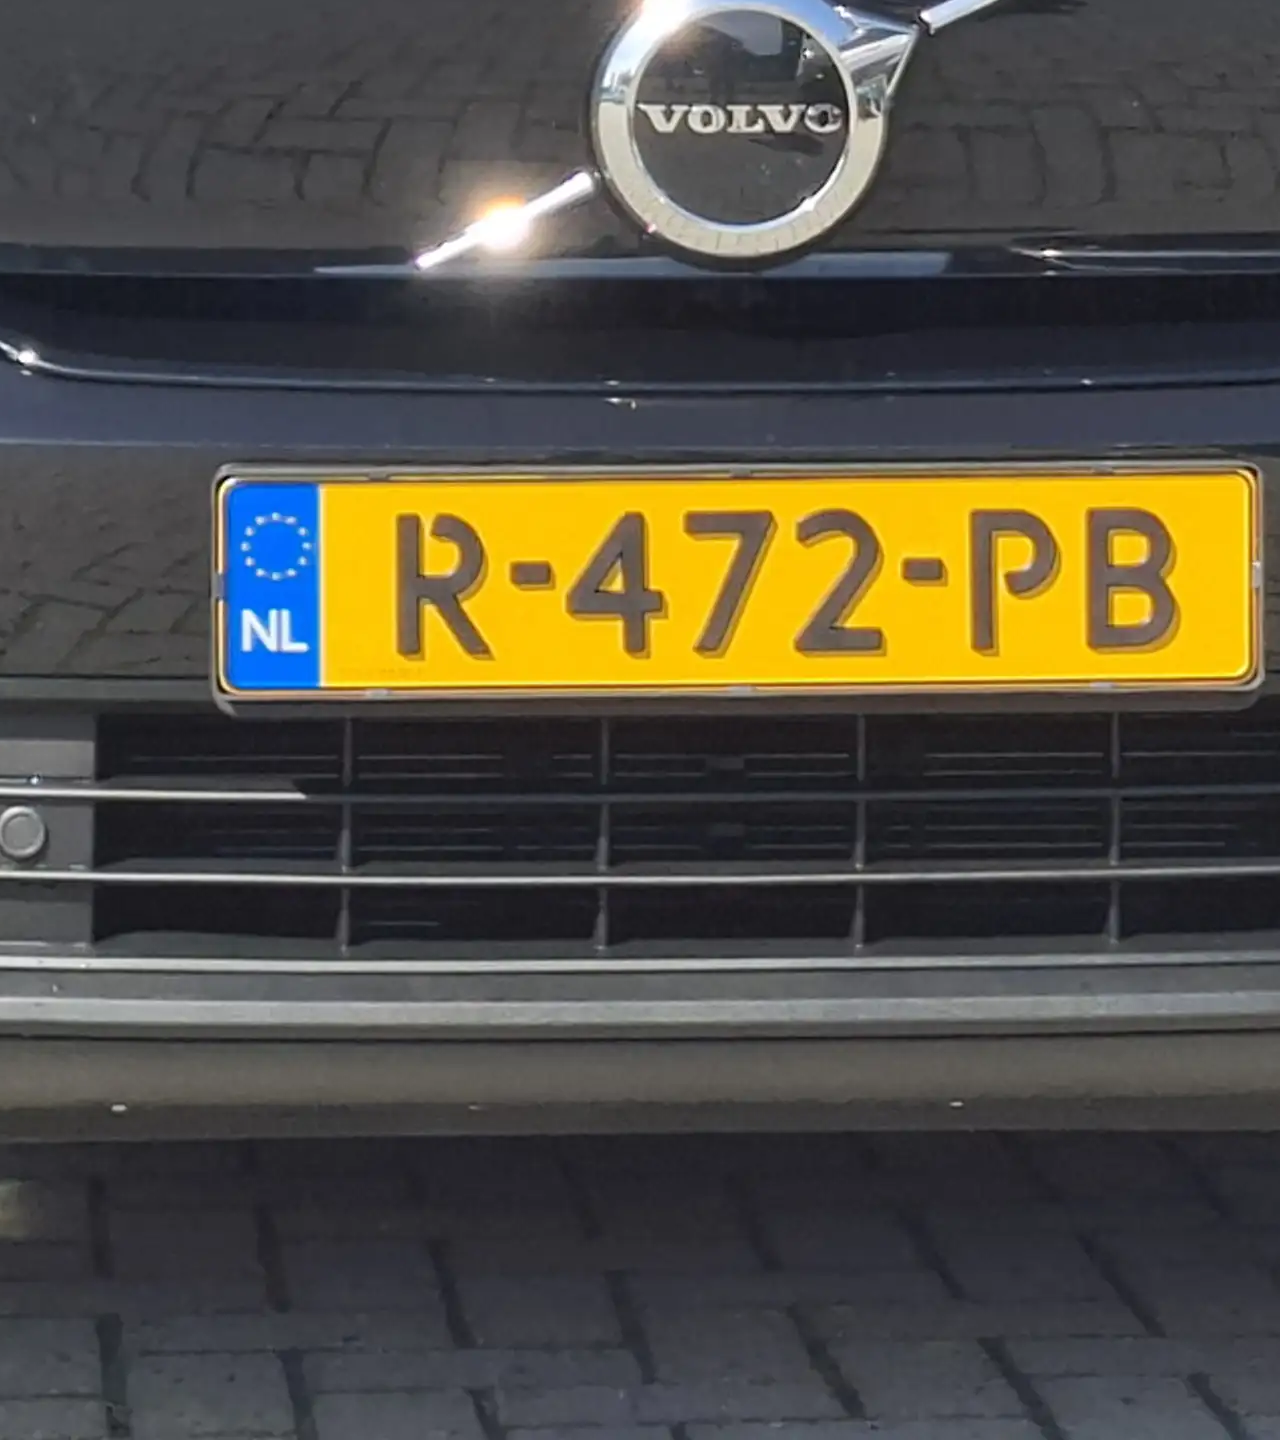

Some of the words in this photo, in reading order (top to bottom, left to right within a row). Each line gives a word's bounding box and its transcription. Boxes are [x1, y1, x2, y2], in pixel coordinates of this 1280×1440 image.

[636, 102, 844, 134] VOLVO
[395, 506, 1182, 661] R-472-PB
[240, 607, 310, 653] NL
